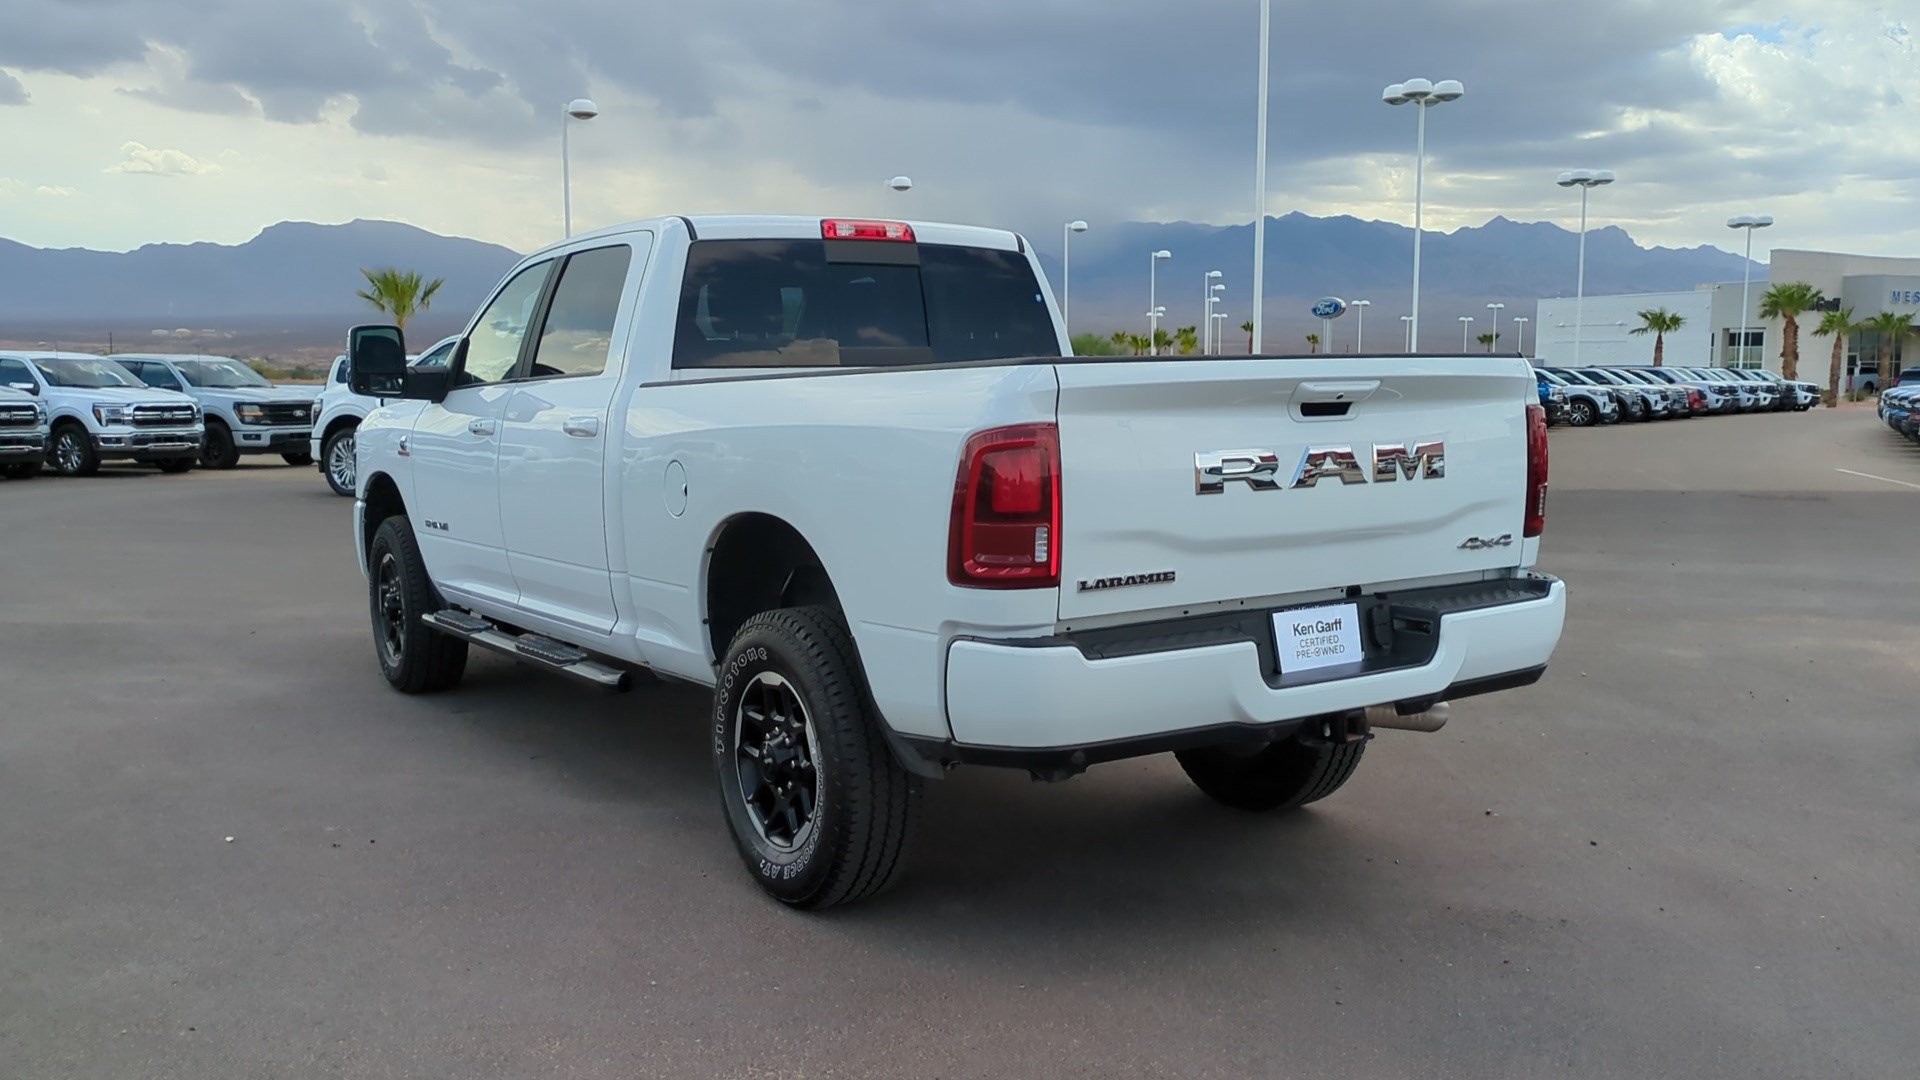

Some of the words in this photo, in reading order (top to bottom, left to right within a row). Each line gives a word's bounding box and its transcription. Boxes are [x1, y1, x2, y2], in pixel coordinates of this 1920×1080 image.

[1316, 301, 1336, 315] Ford
[1194, 441, 1445, 495] RAM
[1077, 571, 1176, 593] LARAMIE
[1292, 623, 1315, 637] Ken
[1315, 618, 1342, 634] Garff
[1299, 635, 1339, 648] CERTIFIED
